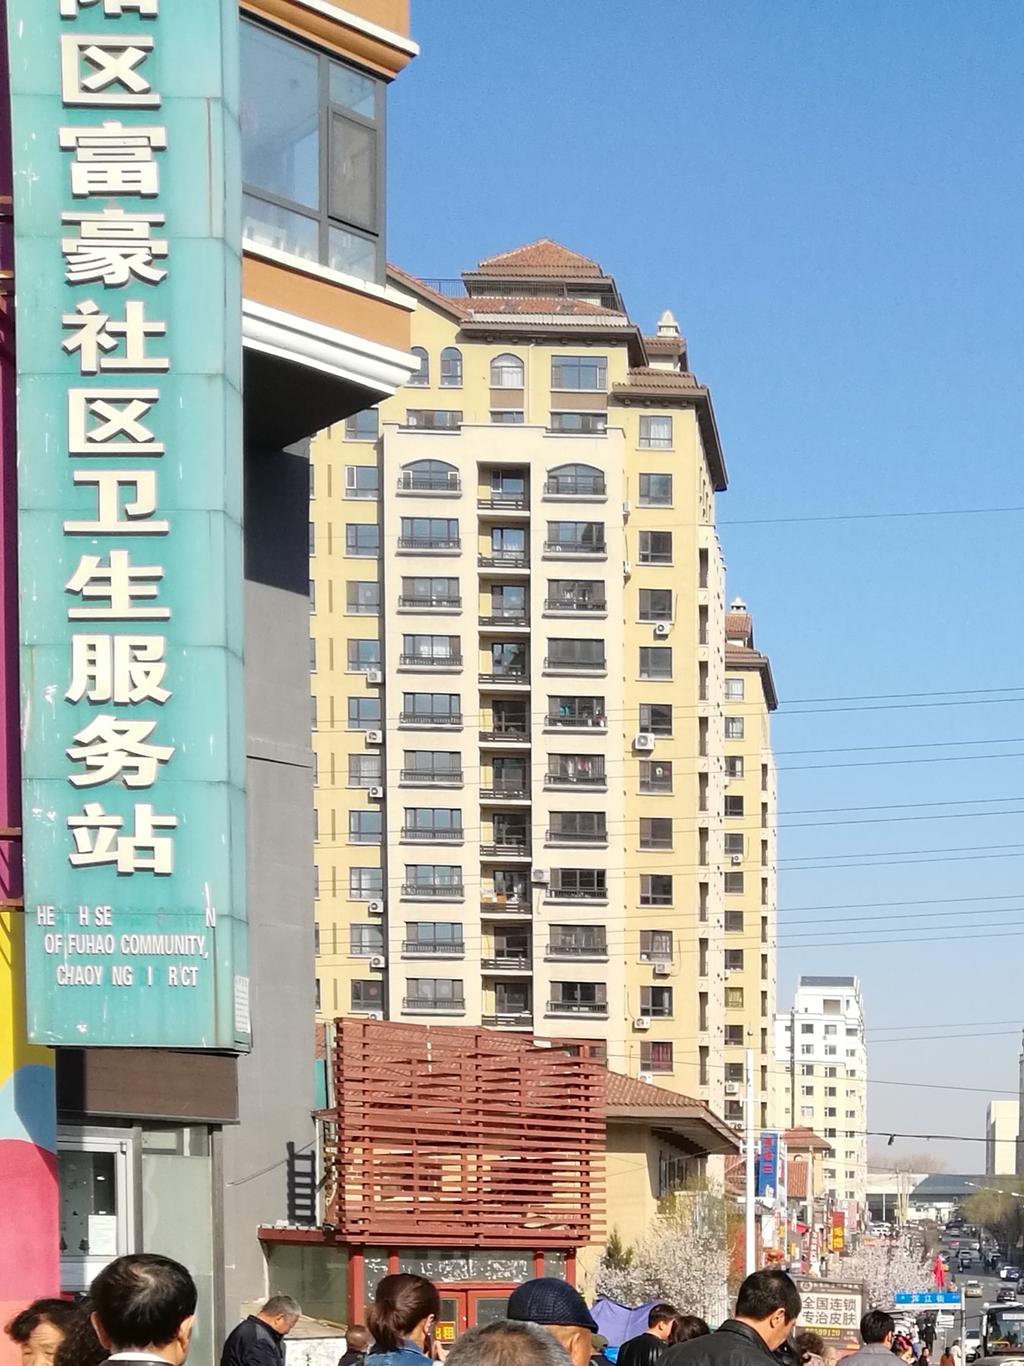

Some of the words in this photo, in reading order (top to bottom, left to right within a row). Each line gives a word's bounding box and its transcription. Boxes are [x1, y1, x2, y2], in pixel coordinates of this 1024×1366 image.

[44, 934, 63, 954] OF
[67, 934, 115, 955] FUHAO
[120, 934, 209, 959] COMMUNITY,
[802, 1296, 857, 1311] 全国连锁
[802, 1310, 857, 1326] 专治皮肤
